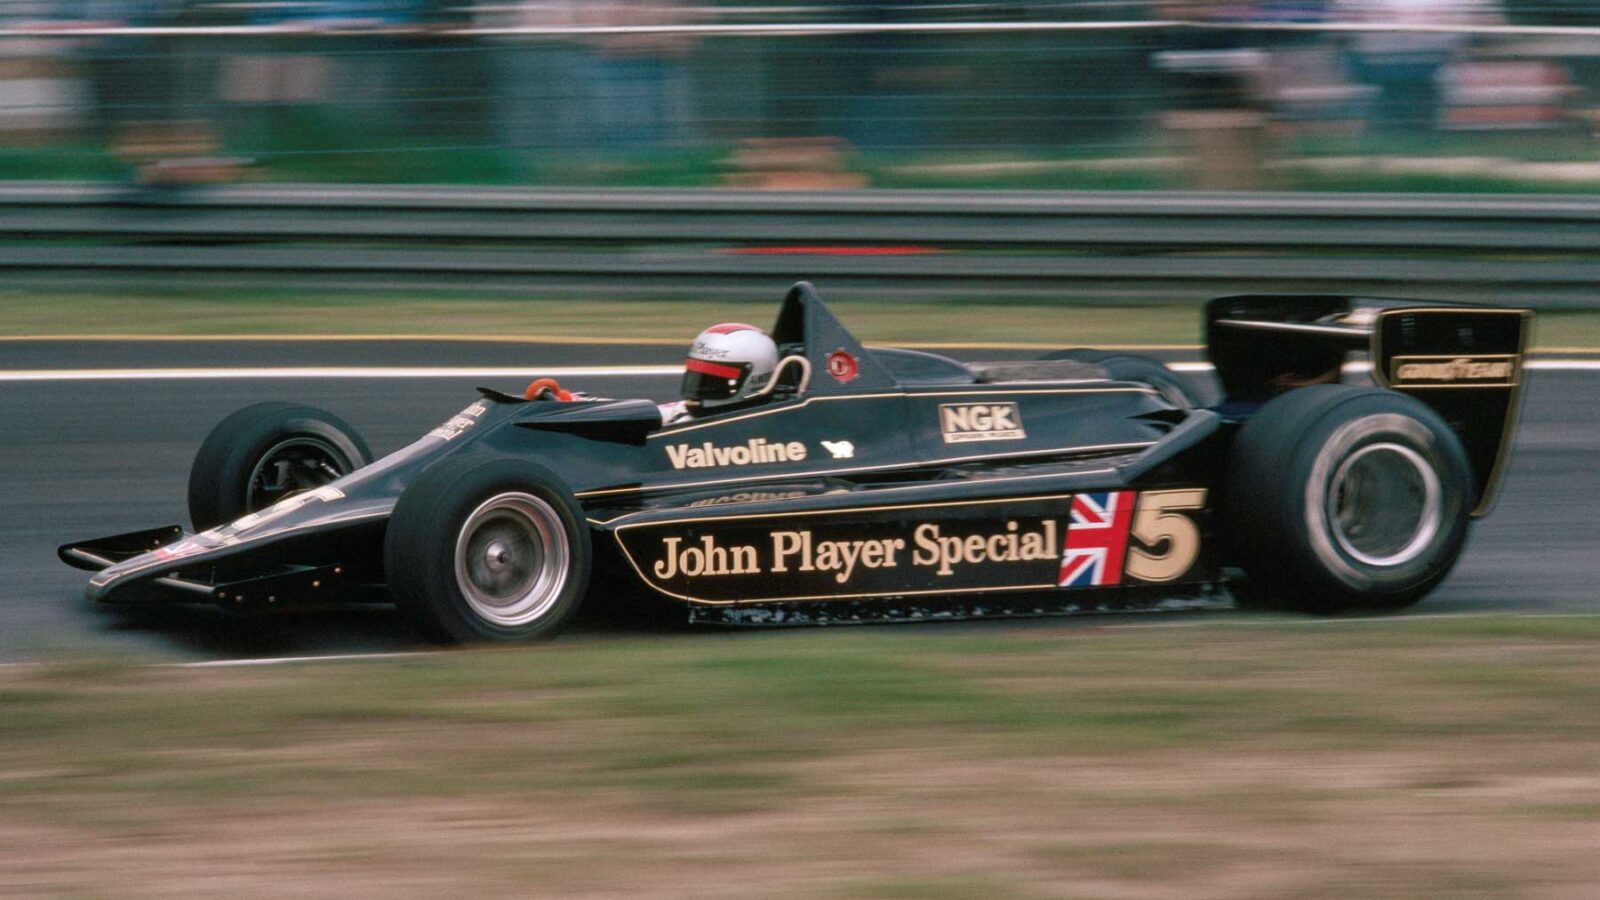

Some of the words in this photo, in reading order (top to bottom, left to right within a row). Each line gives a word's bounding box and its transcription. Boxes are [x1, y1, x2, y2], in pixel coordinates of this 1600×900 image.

[943, 405, 1017, 432] NGK
[665, 438, 807, 469] Valvoline
[654, 535, 760, 579] John
[770, 530, 905, 583] Player
[912, 519, 1059, 576] Special
[1125, 488, 1208, 582] 5
